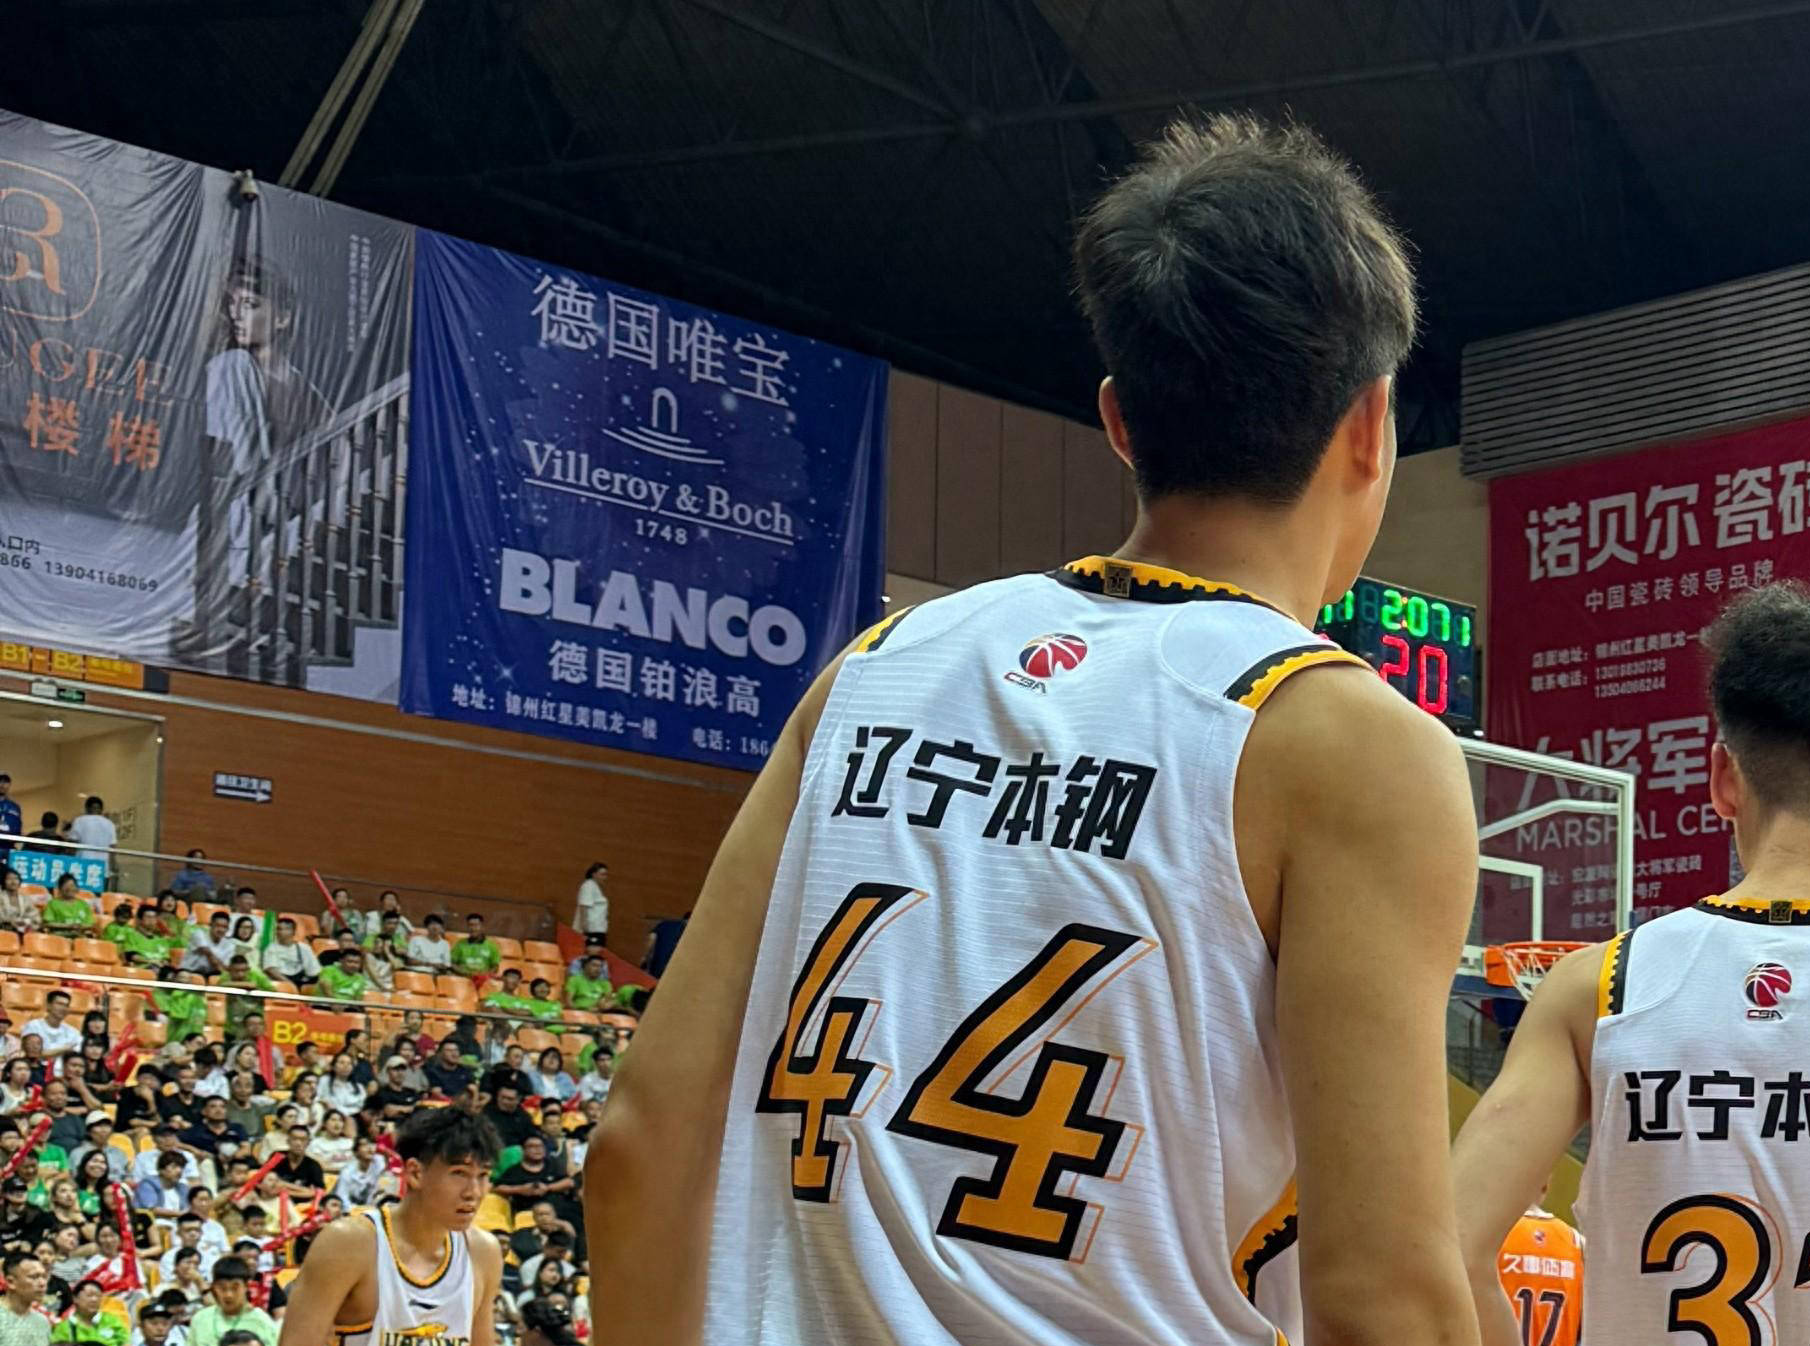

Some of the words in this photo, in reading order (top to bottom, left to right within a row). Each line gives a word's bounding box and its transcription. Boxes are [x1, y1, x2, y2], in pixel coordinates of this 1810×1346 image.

[531, 272, 789, 407] 德国唯宝
[524, 439, 668, 512] Villeroy
[676, 488, 702, 514] &
[704, 484, 794, 537] Boch
[635, 519, 688, 546] 1748
[1525, 484, 1700, 581] 诺贝尔
[501, 548, 806, 666] BLANCO
[550, 639, 761, 717] 德国铂浪高
[831, 726, 1158, 861] 辽宁本钢
[1676, 803, 1729, 835] CE
[272, 1020, 308, 1044] B2
[755, 881, 1159, 1264] 44
